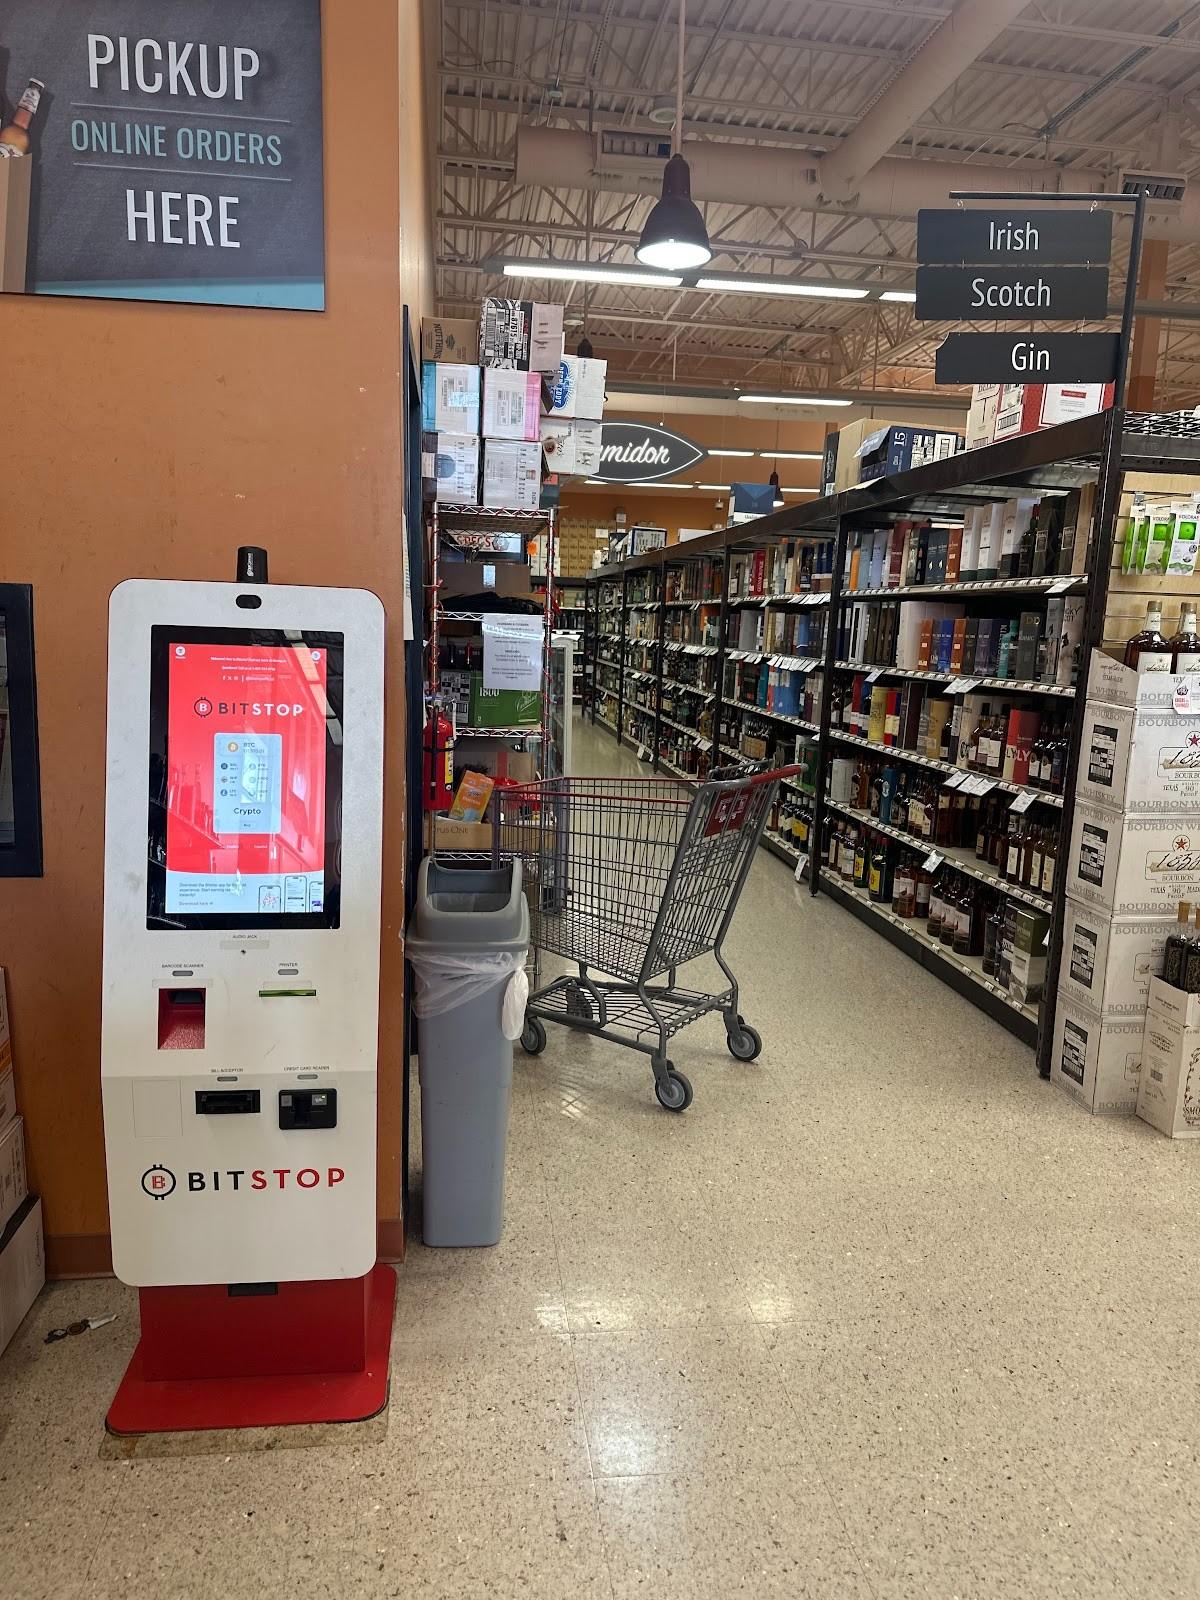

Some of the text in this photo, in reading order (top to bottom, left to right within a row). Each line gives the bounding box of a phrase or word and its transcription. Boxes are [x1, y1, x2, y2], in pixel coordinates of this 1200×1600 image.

[87, 33, 260, 101] PICKUP
[71, 119, 283, 166] ONLINE ORDERS
[126, 189, 241, 249] HERE
[989, 221, 1039, 251] Irish
[970, 278, 1050, 307] Scotch
[1011, 343, 1050, 371] Gin
[554, 387, 563, 404] EDDY
[893, 432, 907, 447] 15
[218, 702, 303, 717] BITSTOP
[1091, 709, 1126, 721] BOURBON
[1138, 719, 1196, 727] BOURBON
[1163, 784, 1179, 792] TEXAS
[233, 807, 261, 815] Crypto
[1127, 823, 1184, 831] BOURBON
[1119, 902, 1175, 910] BOURBON
[1115, 926, 1172, 935] BOURBON
[188, 1167, 345, 1192] BITSTOP
